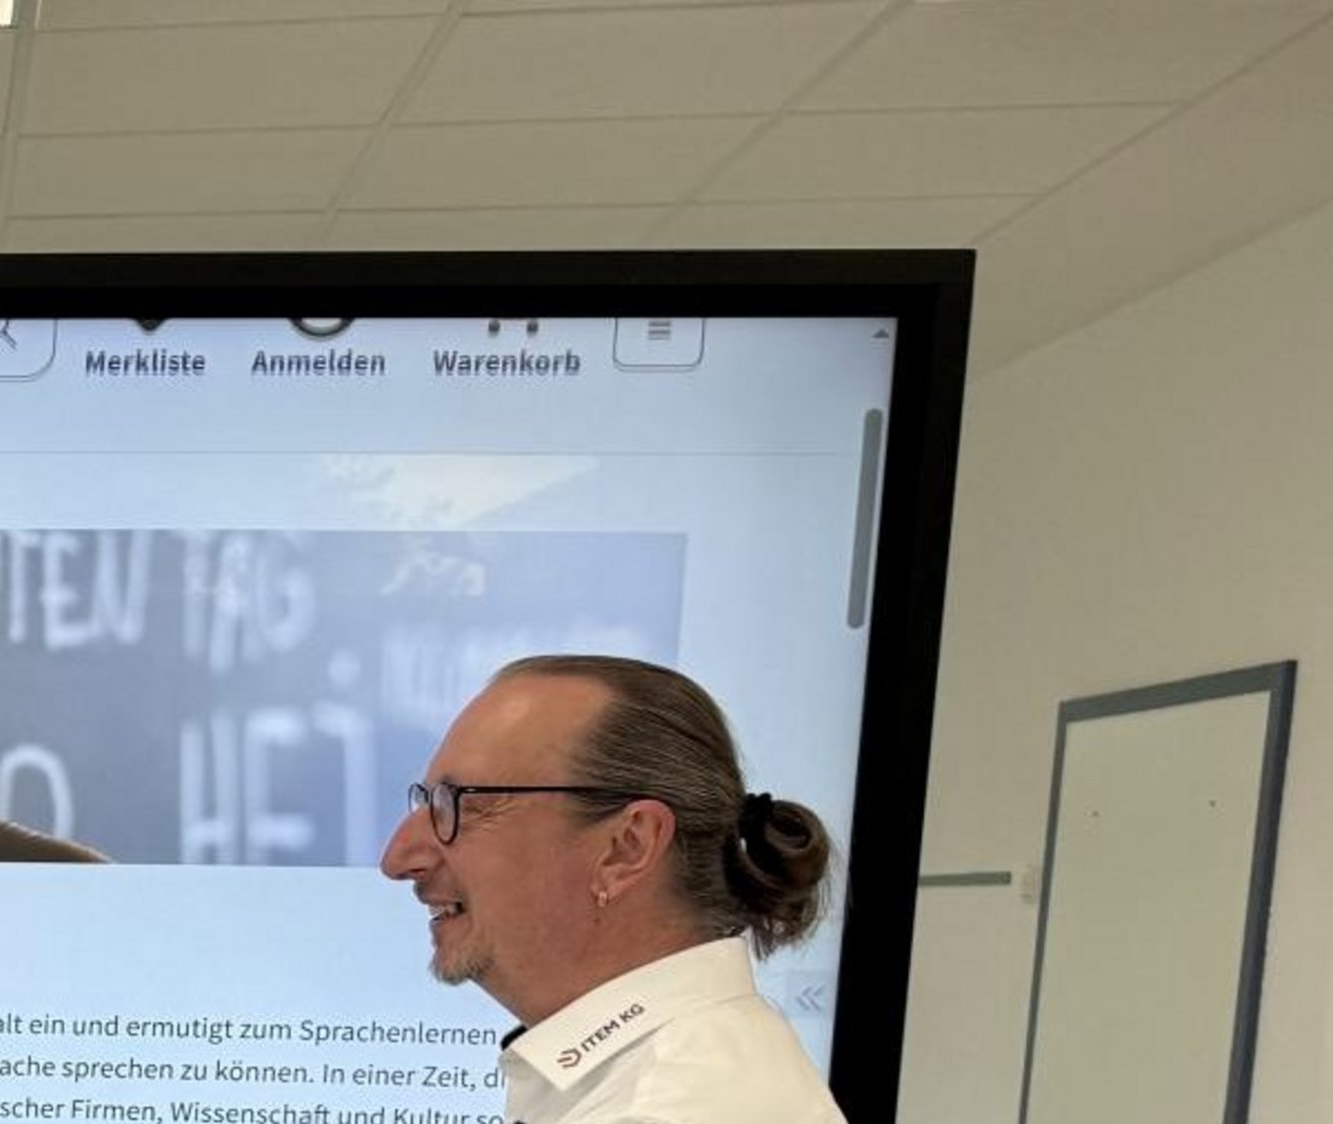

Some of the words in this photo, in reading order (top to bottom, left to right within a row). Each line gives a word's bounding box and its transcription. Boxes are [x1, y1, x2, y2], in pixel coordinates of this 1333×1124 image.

[85, 348, 206, 376] Merkliste
[251, 348, 386, 376] Anmelden
[433, 349, 581, 376] Warenkorb
[28, 1013, 66, 1036] ein
[72, 1015, 120, 1037] und
[125, 1017, 233, 1046] ermutigt
[239, 1023, 292, 1040] zum
[299, 1019, 497, 1047] Sprachenlernen
[581, 1019, 621, 1051] ITEM
[620, 1003, 645, 1023] KG
[61, 1057, 174, 1083] sprechen
[180, 1063, 208, 1082] zu
[214, 1059, 315, 1084] können.
[322, 1063, 346, 1084] In
[351, 1063, 417, 1087] einer
[421, 1065, 477, 1092] Zeit,
